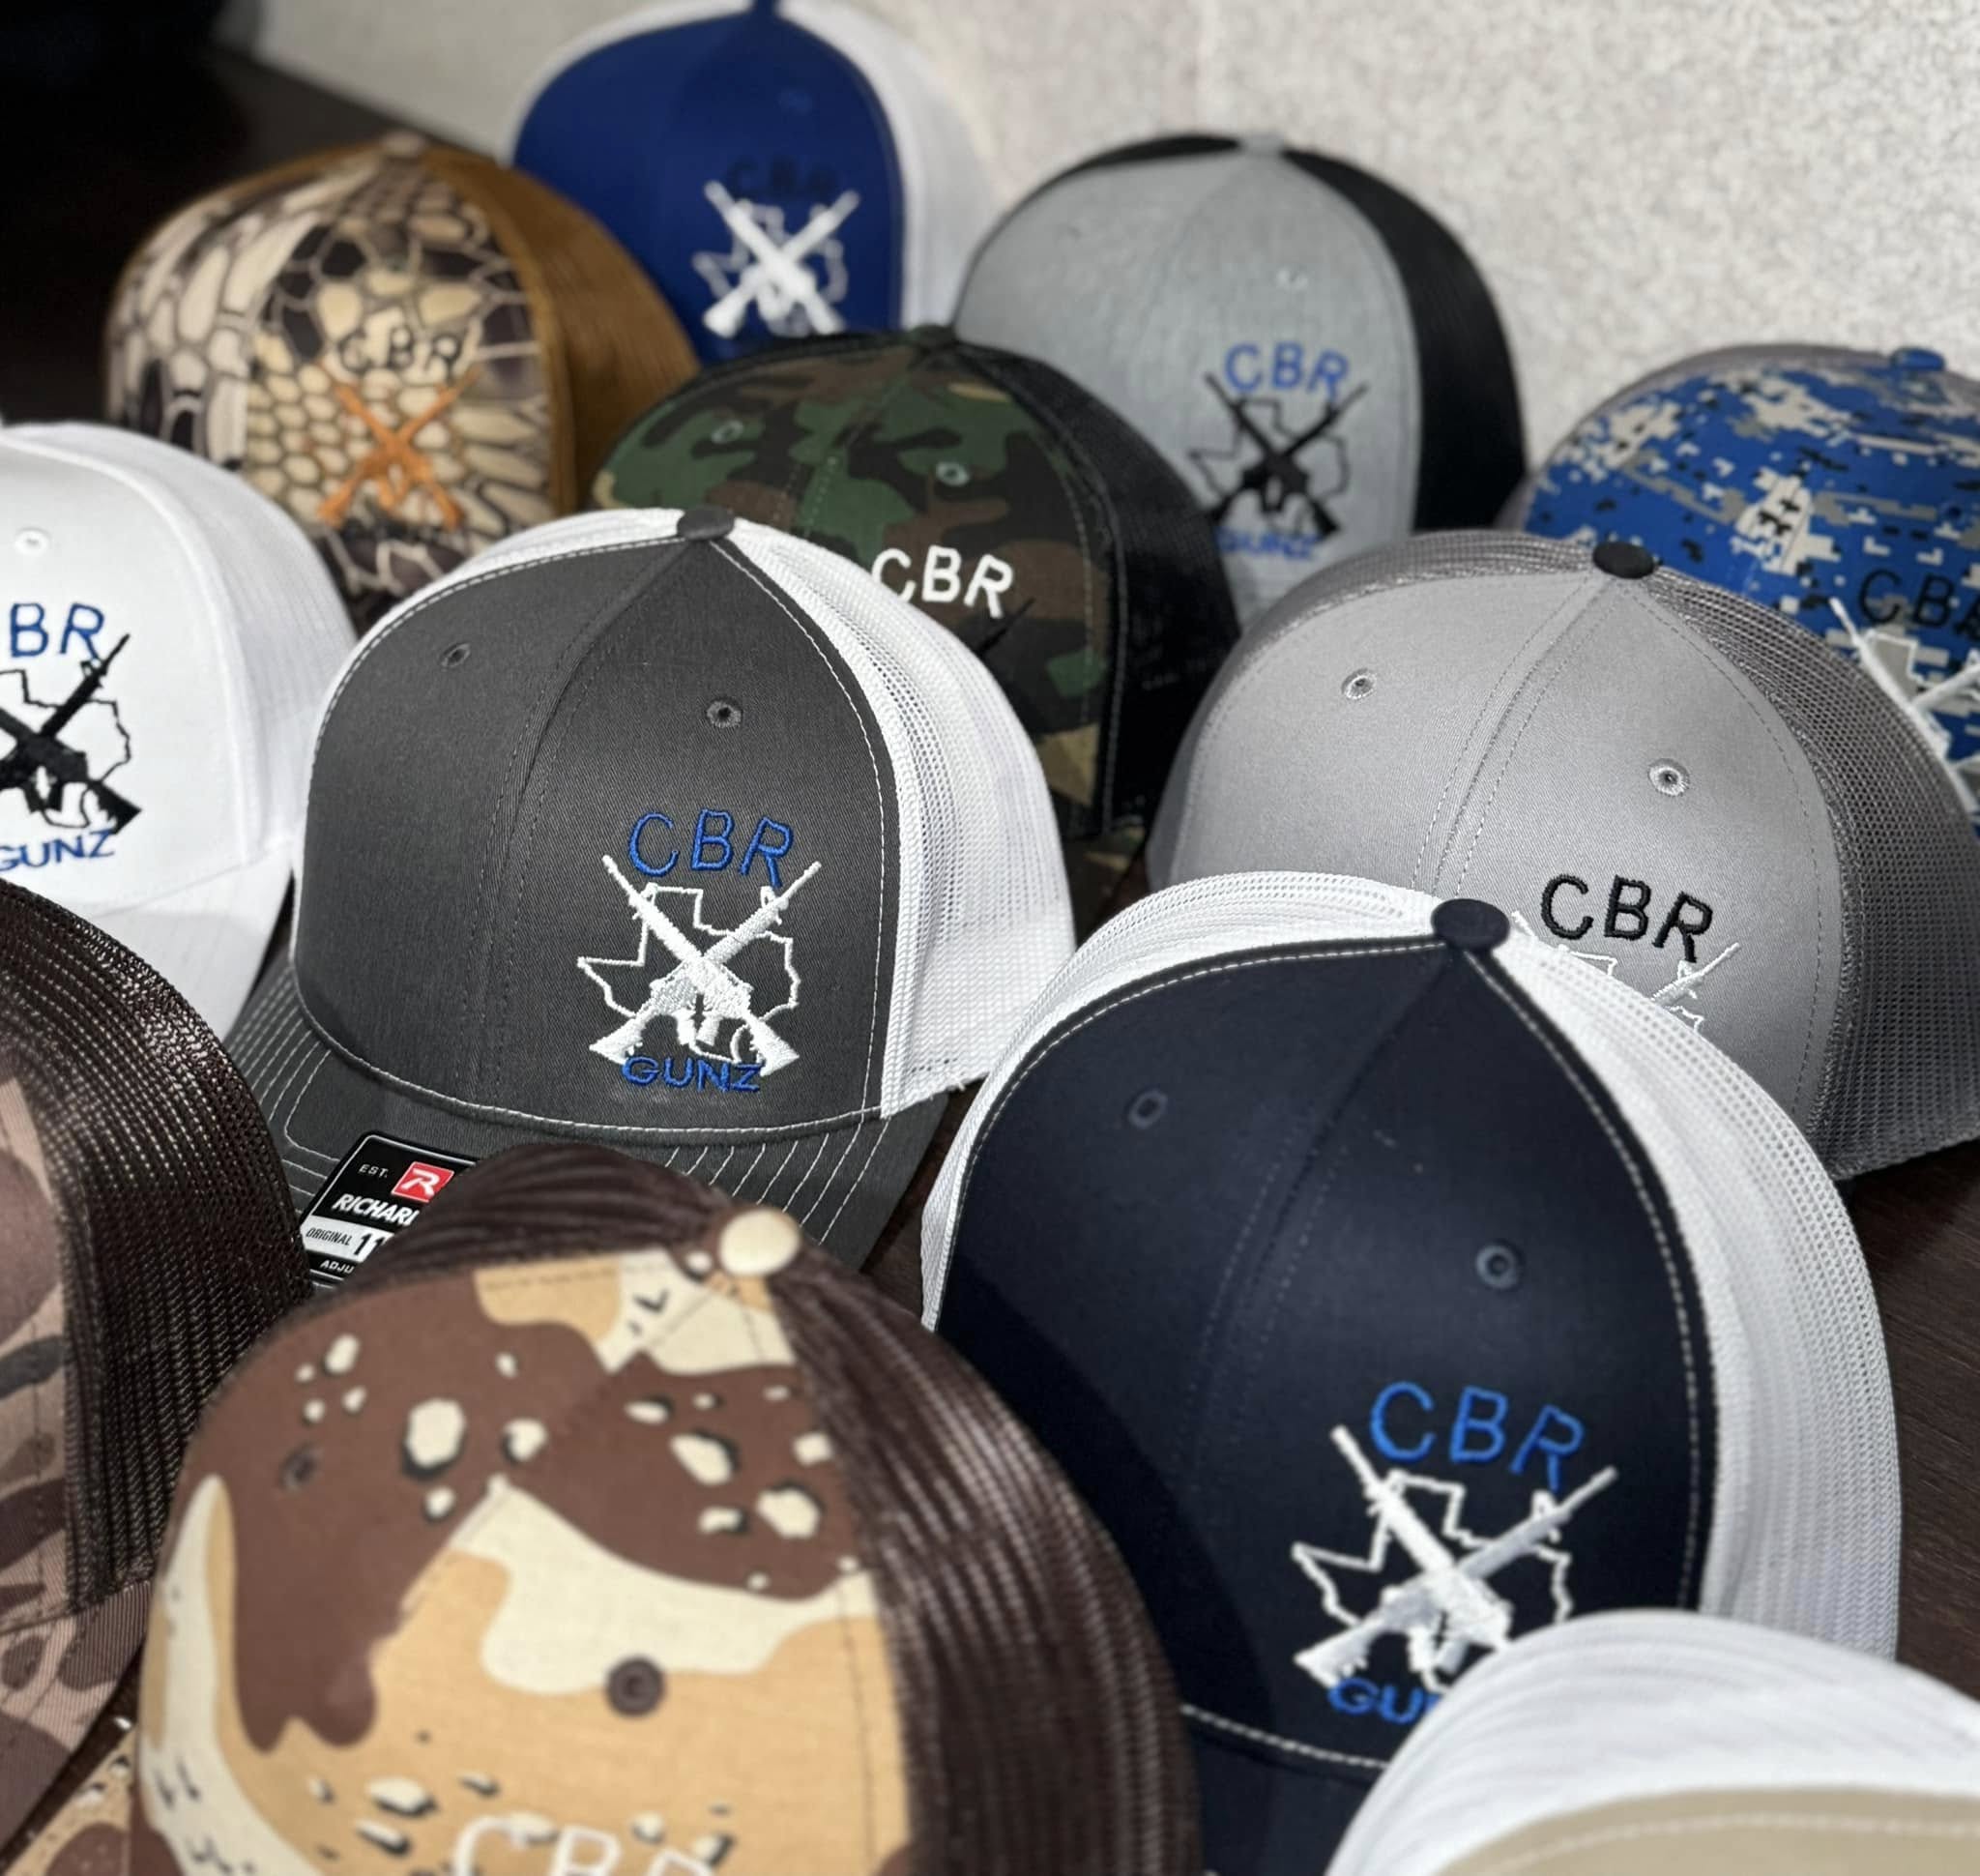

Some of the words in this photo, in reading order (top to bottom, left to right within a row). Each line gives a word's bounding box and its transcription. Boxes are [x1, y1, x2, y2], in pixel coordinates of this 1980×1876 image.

[1224, 341, 1350, 403] CBR
[872, 544, 1013, 619] CBR
[628, 807, 794, 889] CBR
[1541, 874, 1713, 963] CBR
[621, 1056, 765, 1092] GUNZ
[359, 1163, 389, 1179] EST.
[306, 1227, 353, 1246] ORIGINAL
[1369, 1381, 1586, 1492] CBR
[1327, 1677, 1439, 1724] GU
